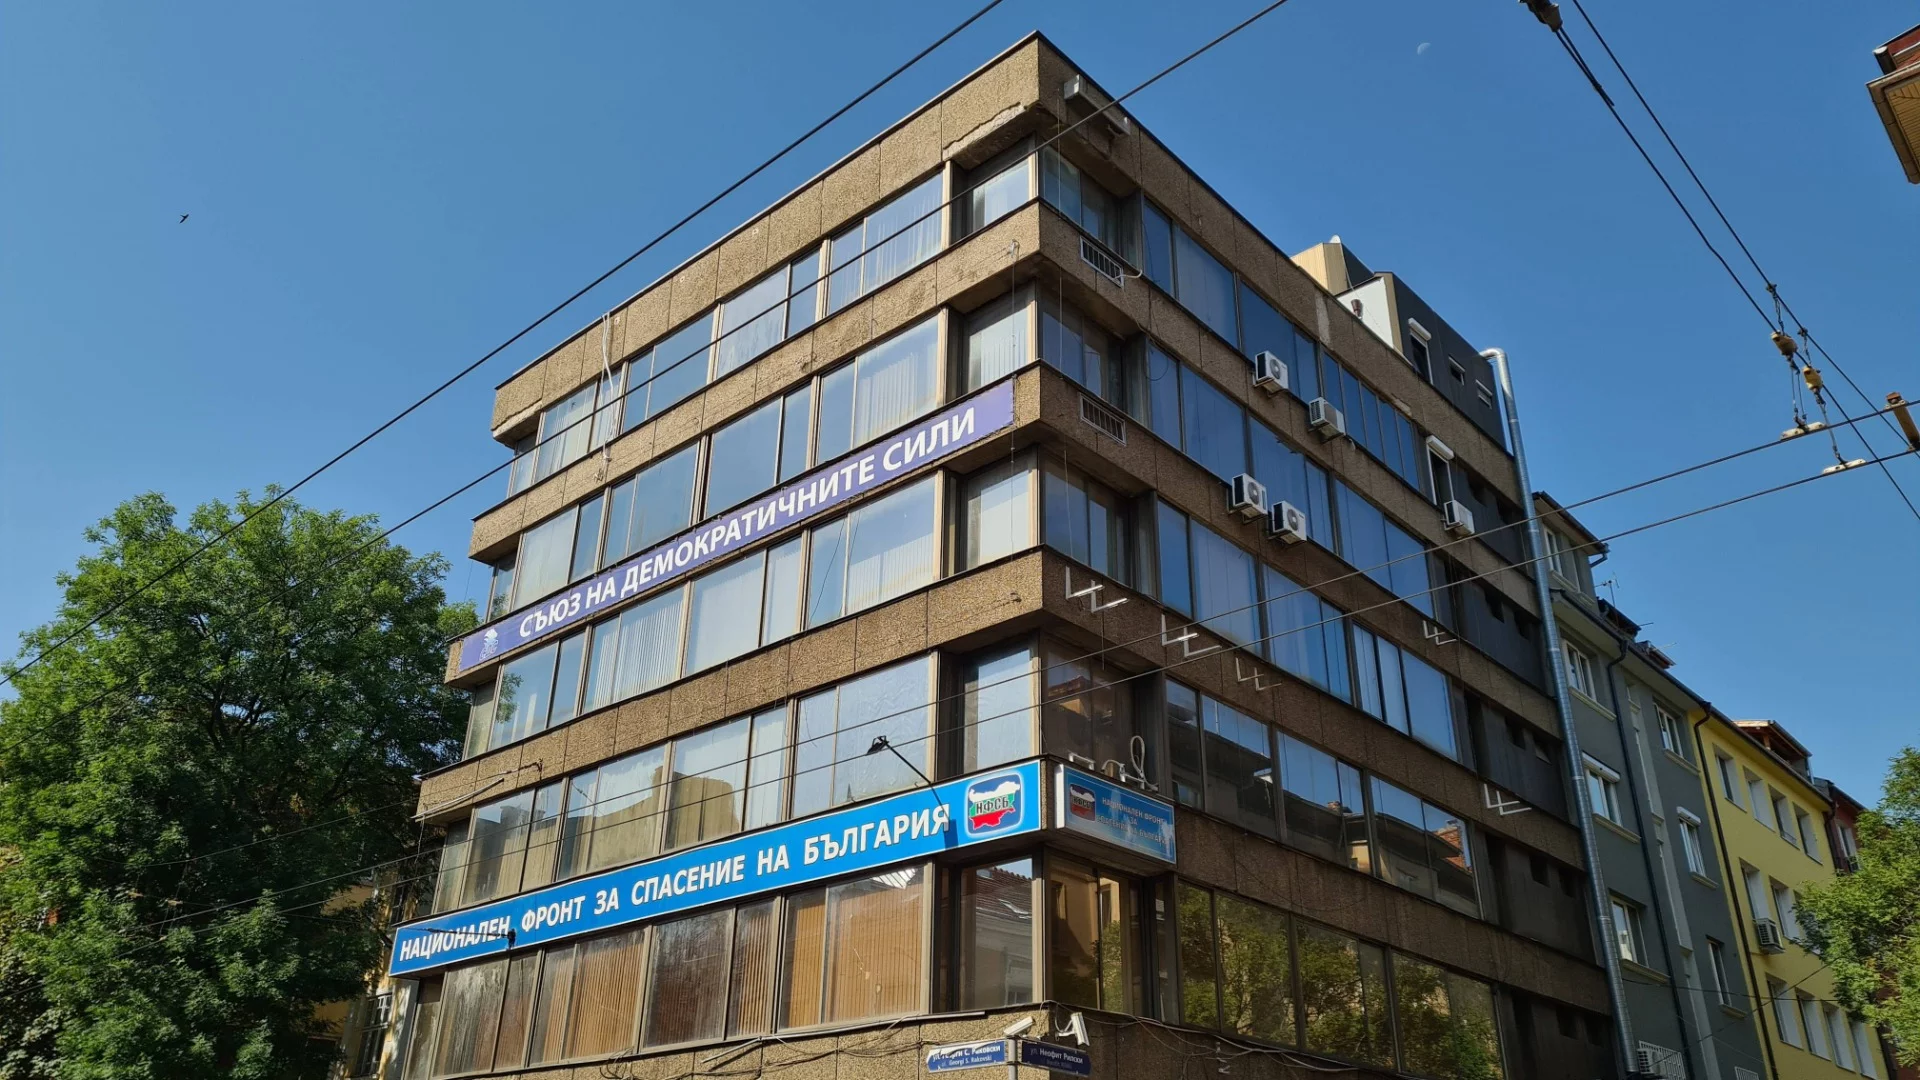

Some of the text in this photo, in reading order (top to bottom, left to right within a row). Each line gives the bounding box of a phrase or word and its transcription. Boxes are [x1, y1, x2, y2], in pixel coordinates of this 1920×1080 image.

[519, 407, 975, 638] СЪЮЗ НА ДЕМОКРАТИЧНИТЕ СИЛИ
[976, 796, 1009, 814] НФСБ
[1139, 829, 1168, 845] БЪЛГАРИ
[399, 803, 950, 962] НАЦИОНАЛЕН ФРОНТ ЗА СПАСЕНИЕ НА БЪЛГАРИЯ
[1040, 1048, 1062, 1060] Неофит
[1063, 1052, 1083, 1064] Рилски
